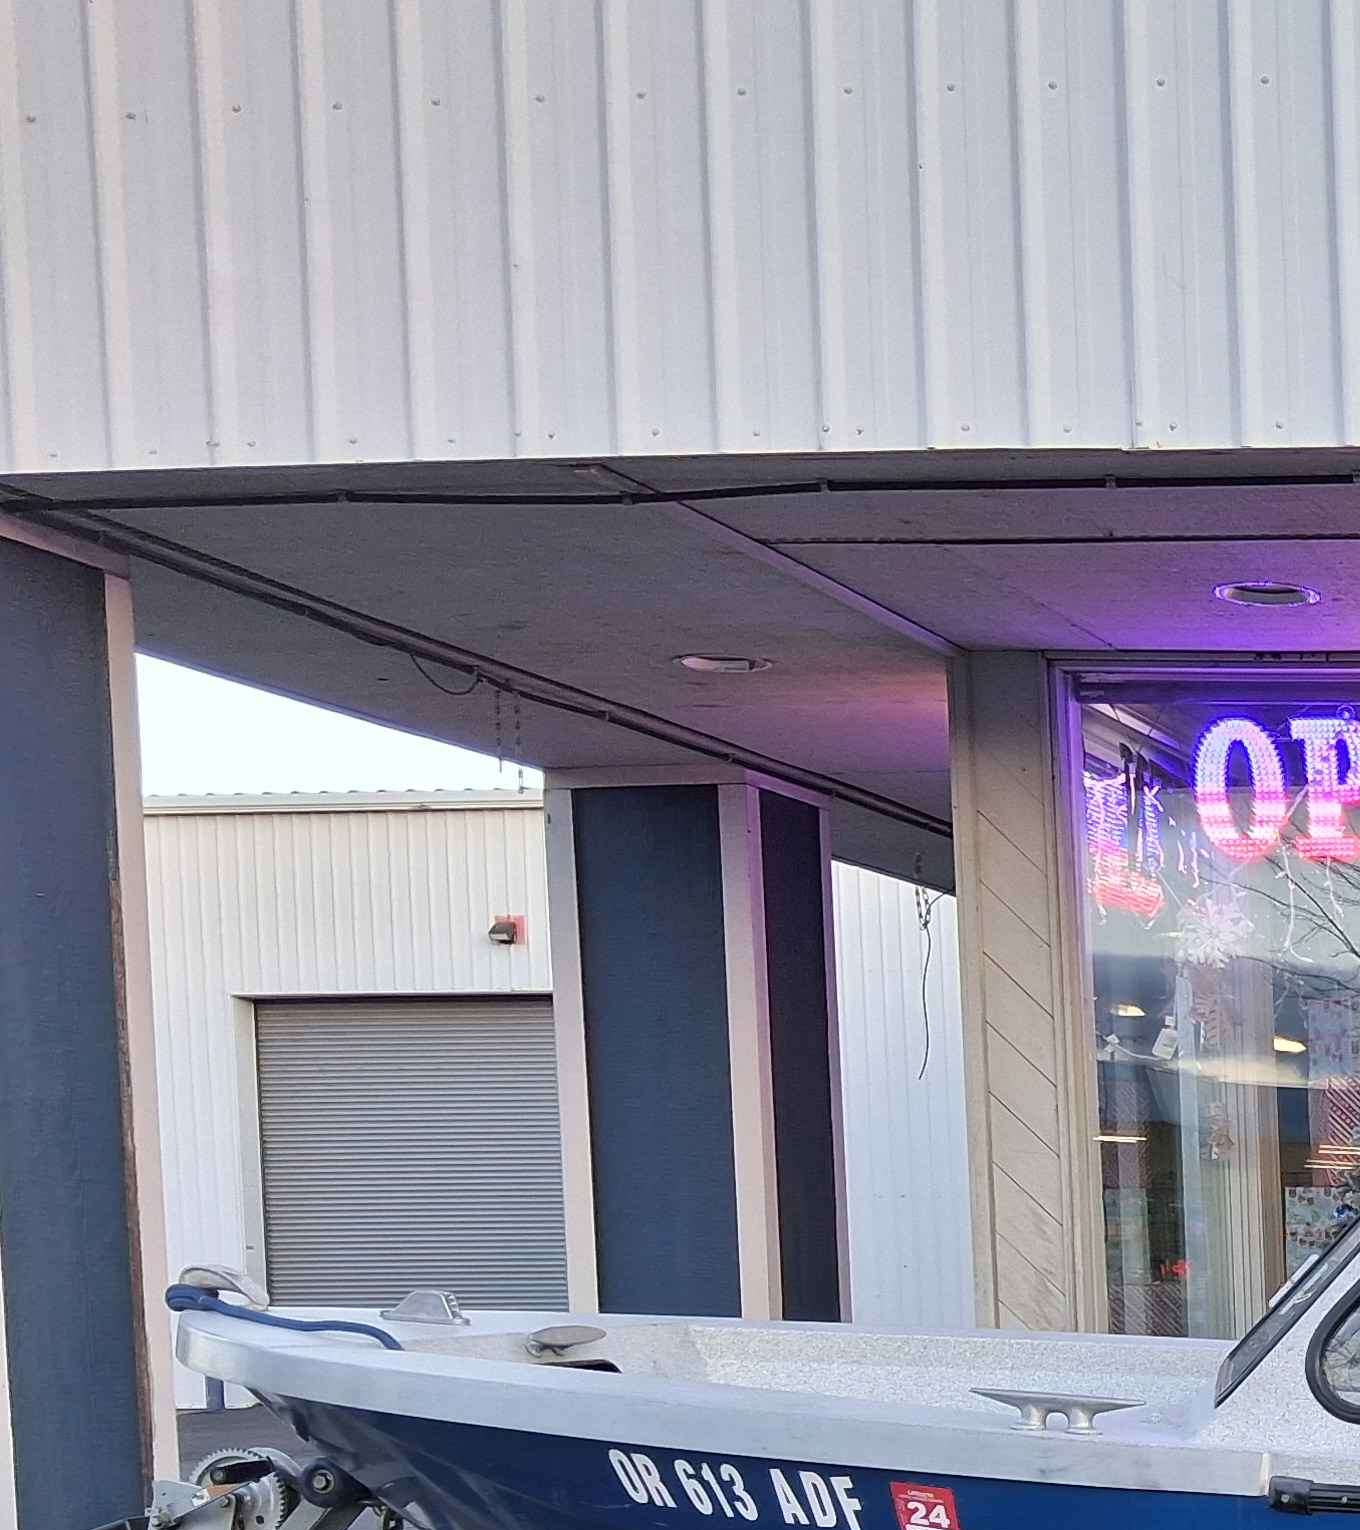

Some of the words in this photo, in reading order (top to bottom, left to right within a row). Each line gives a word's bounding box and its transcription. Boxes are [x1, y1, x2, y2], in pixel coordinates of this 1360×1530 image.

[608, 1448, 676, 1508] OR
[673, 1459, 759, 1521] 613
[907, 1501, 951, 1529] 24
